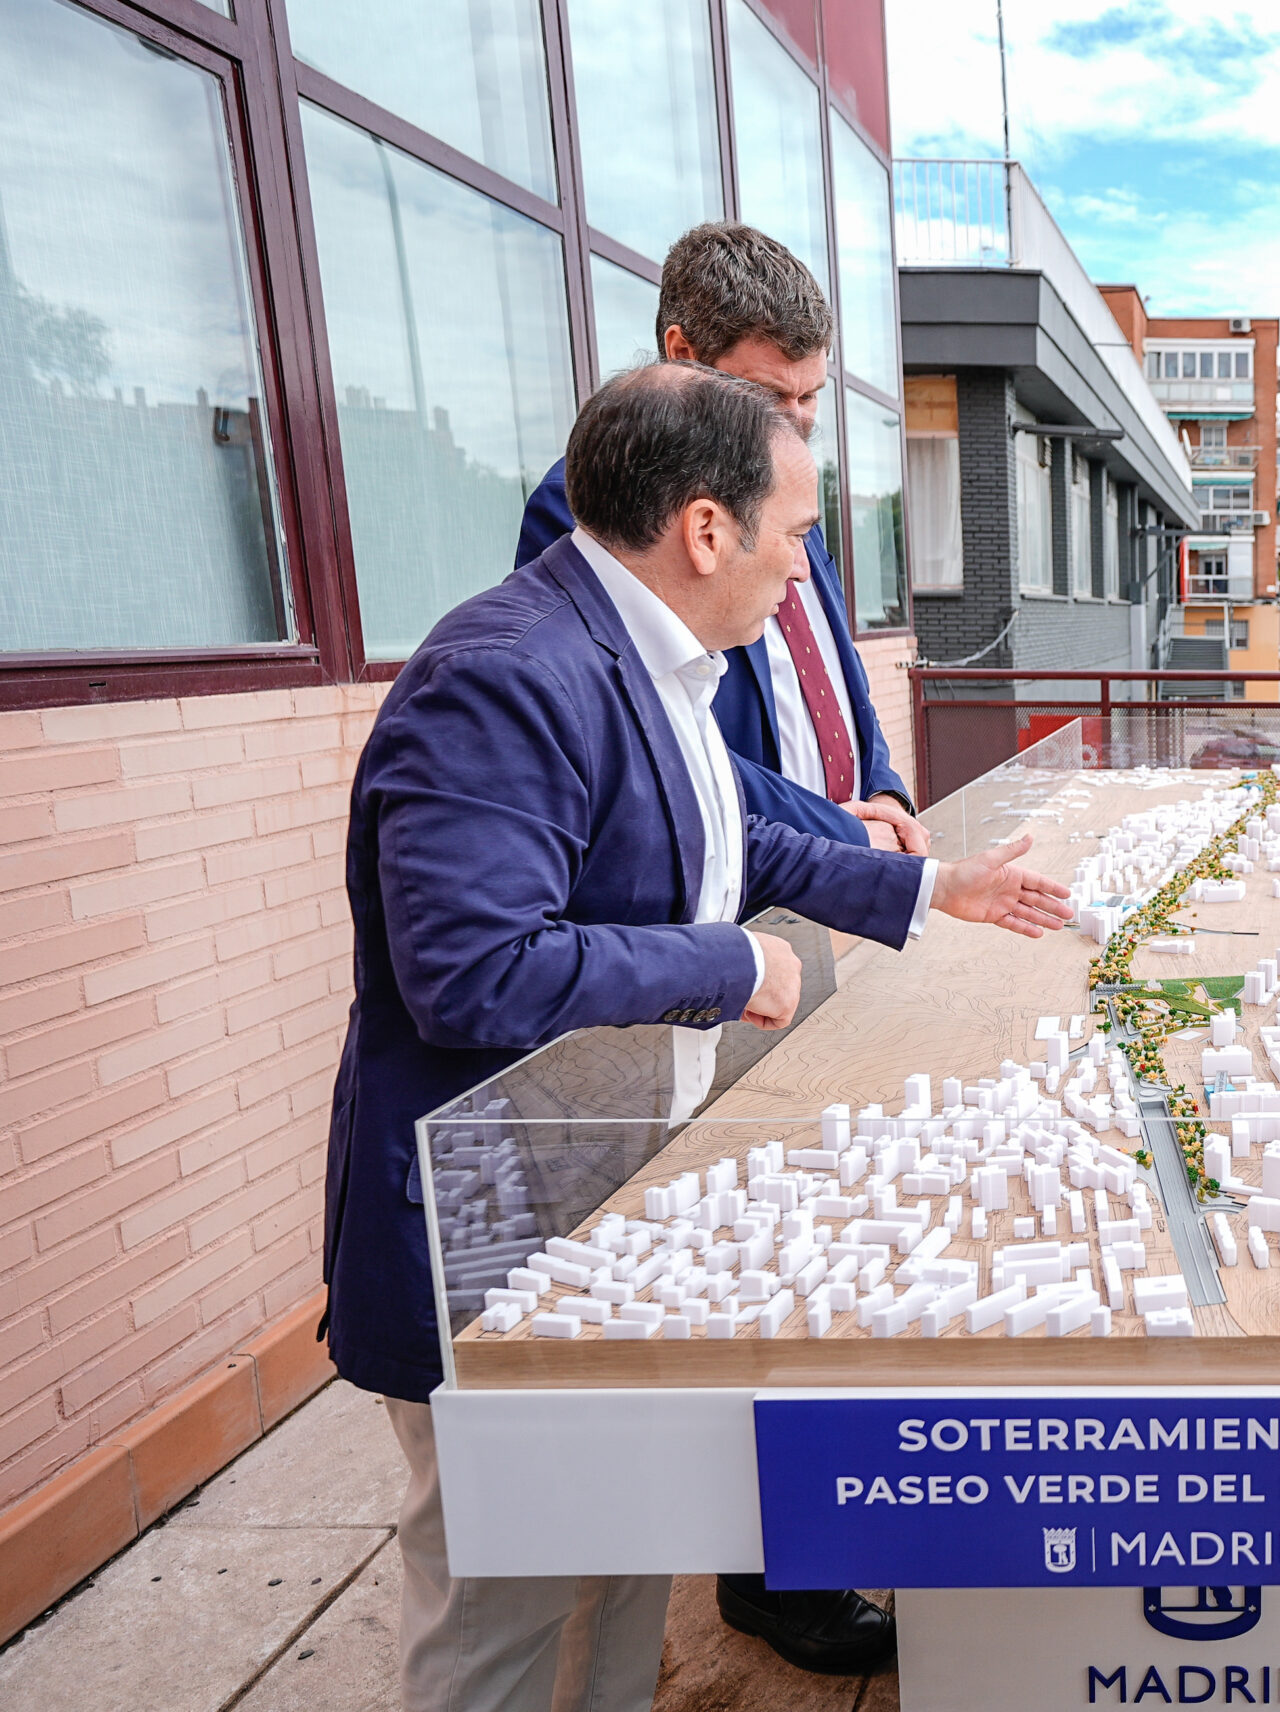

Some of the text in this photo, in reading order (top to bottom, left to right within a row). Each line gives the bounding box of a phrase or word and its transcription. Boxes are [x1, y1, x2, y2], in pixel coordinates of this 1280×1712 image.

[836, 1475, 989, 1505] PASEO
[1003, 1474, 1160, 1504] VERDE
[1177, 1474, 1266, 1503] DEL
